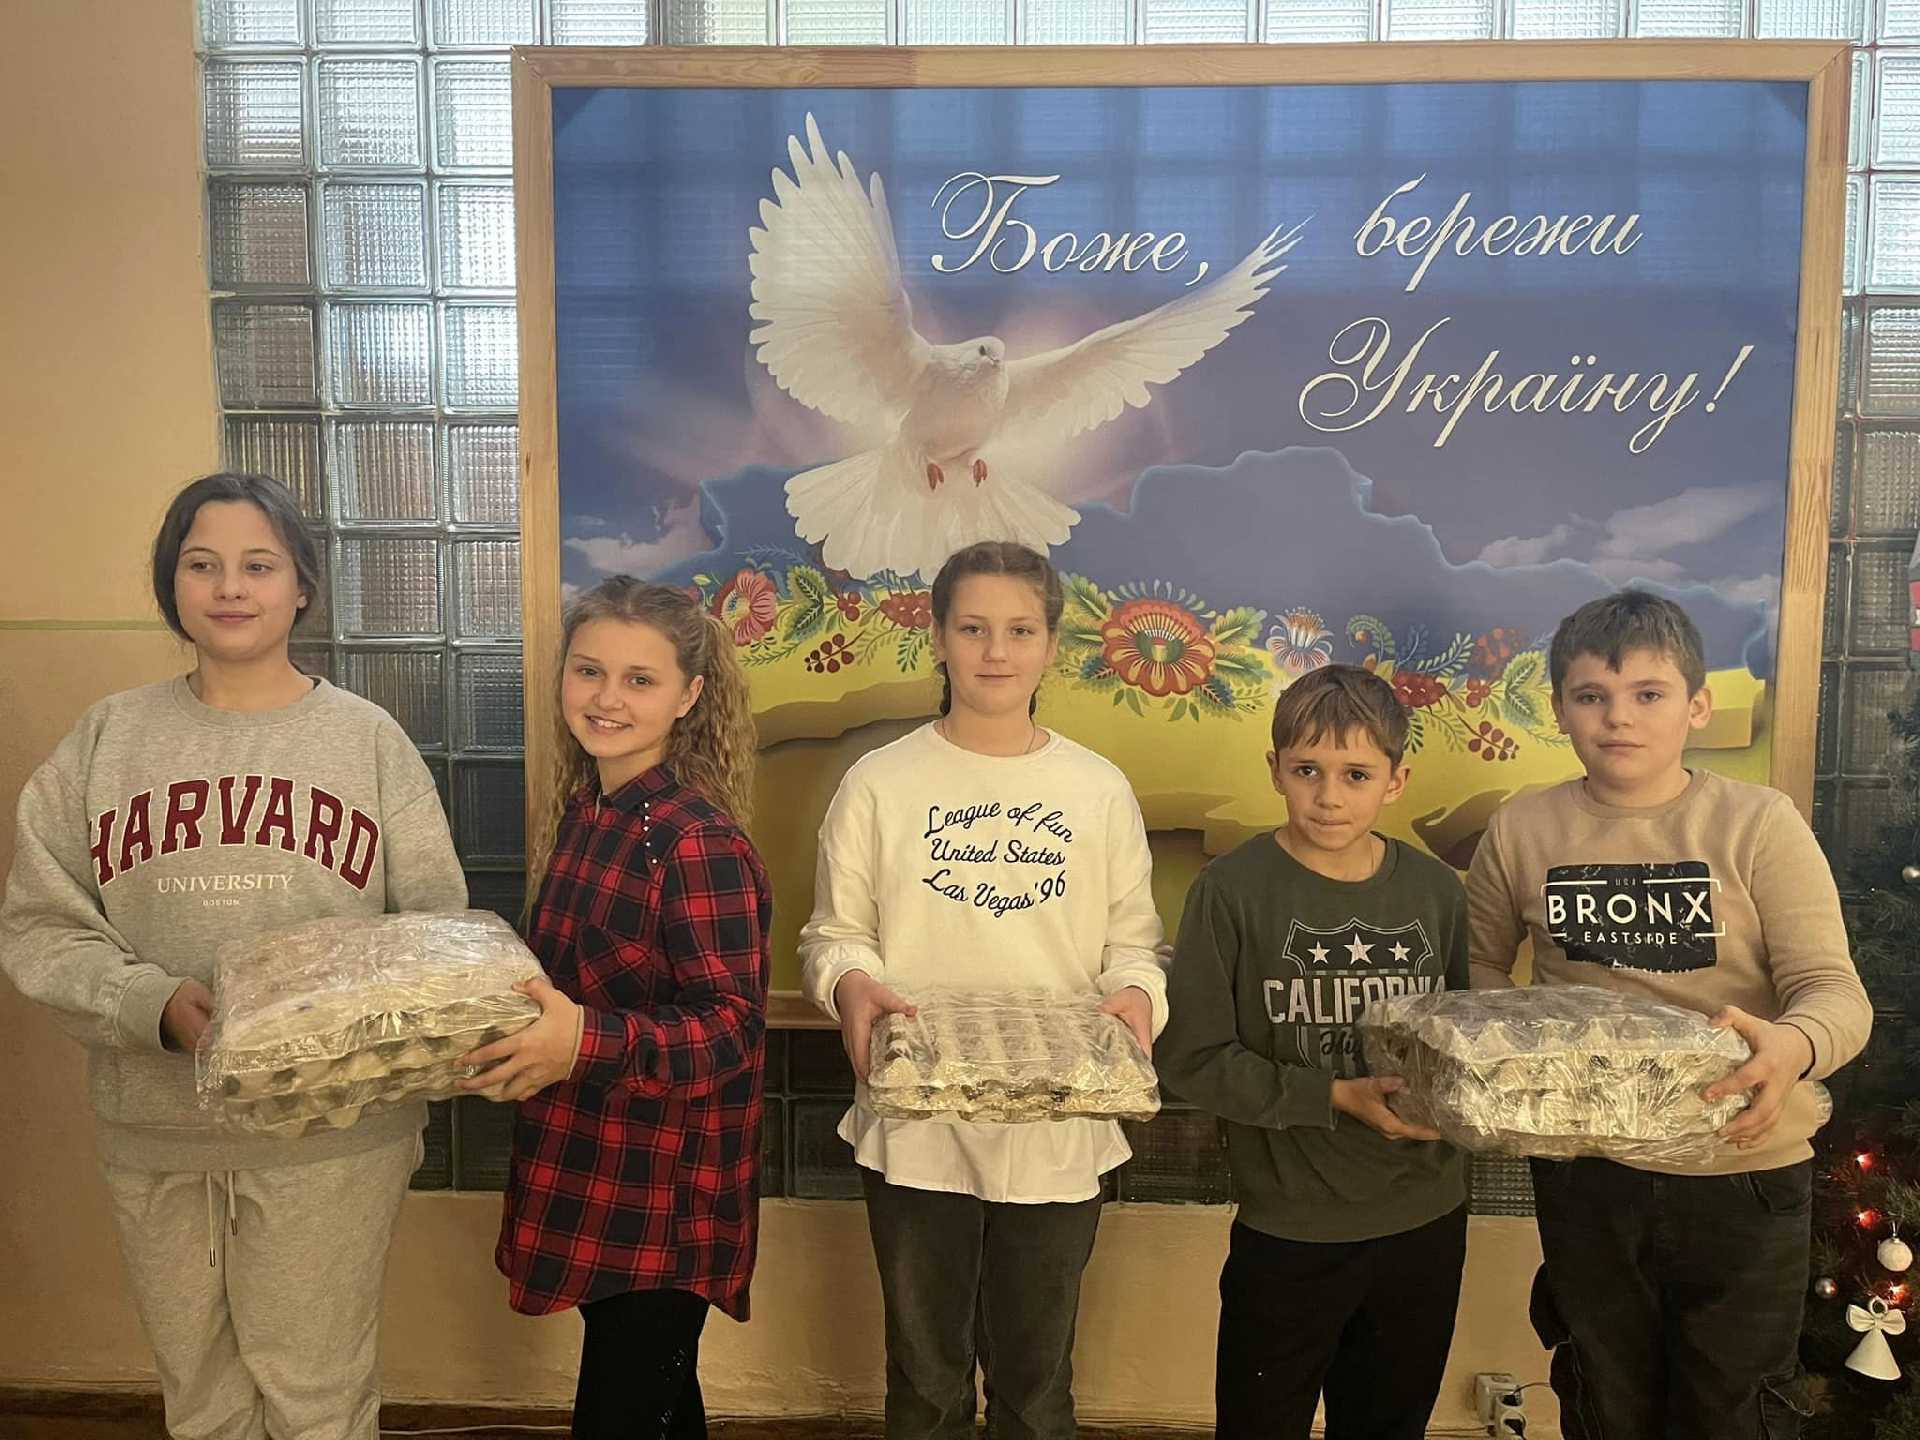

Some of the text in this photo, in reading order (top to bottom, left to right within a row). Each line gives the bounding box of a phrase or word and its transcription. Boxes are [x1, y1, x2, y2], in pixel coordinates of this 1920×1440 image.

[930, 171, 1644, 293] Боже, бережи
[1298, 316, 1756, 454] Україну!
[89, 773, 382, 892] HARVARD
[923, 802, 1073, 843] League of fun
[930, 837, 1066, 866] United States
[156, 872, 294, 894] UNIVERSITY
[921, 868, 969, 902] Las
[973, 882, 1035, 919] Vegas
[1547, 890, 1712, 926] BRONX
[1583, 930, 1678, 946] EASTSIDE
